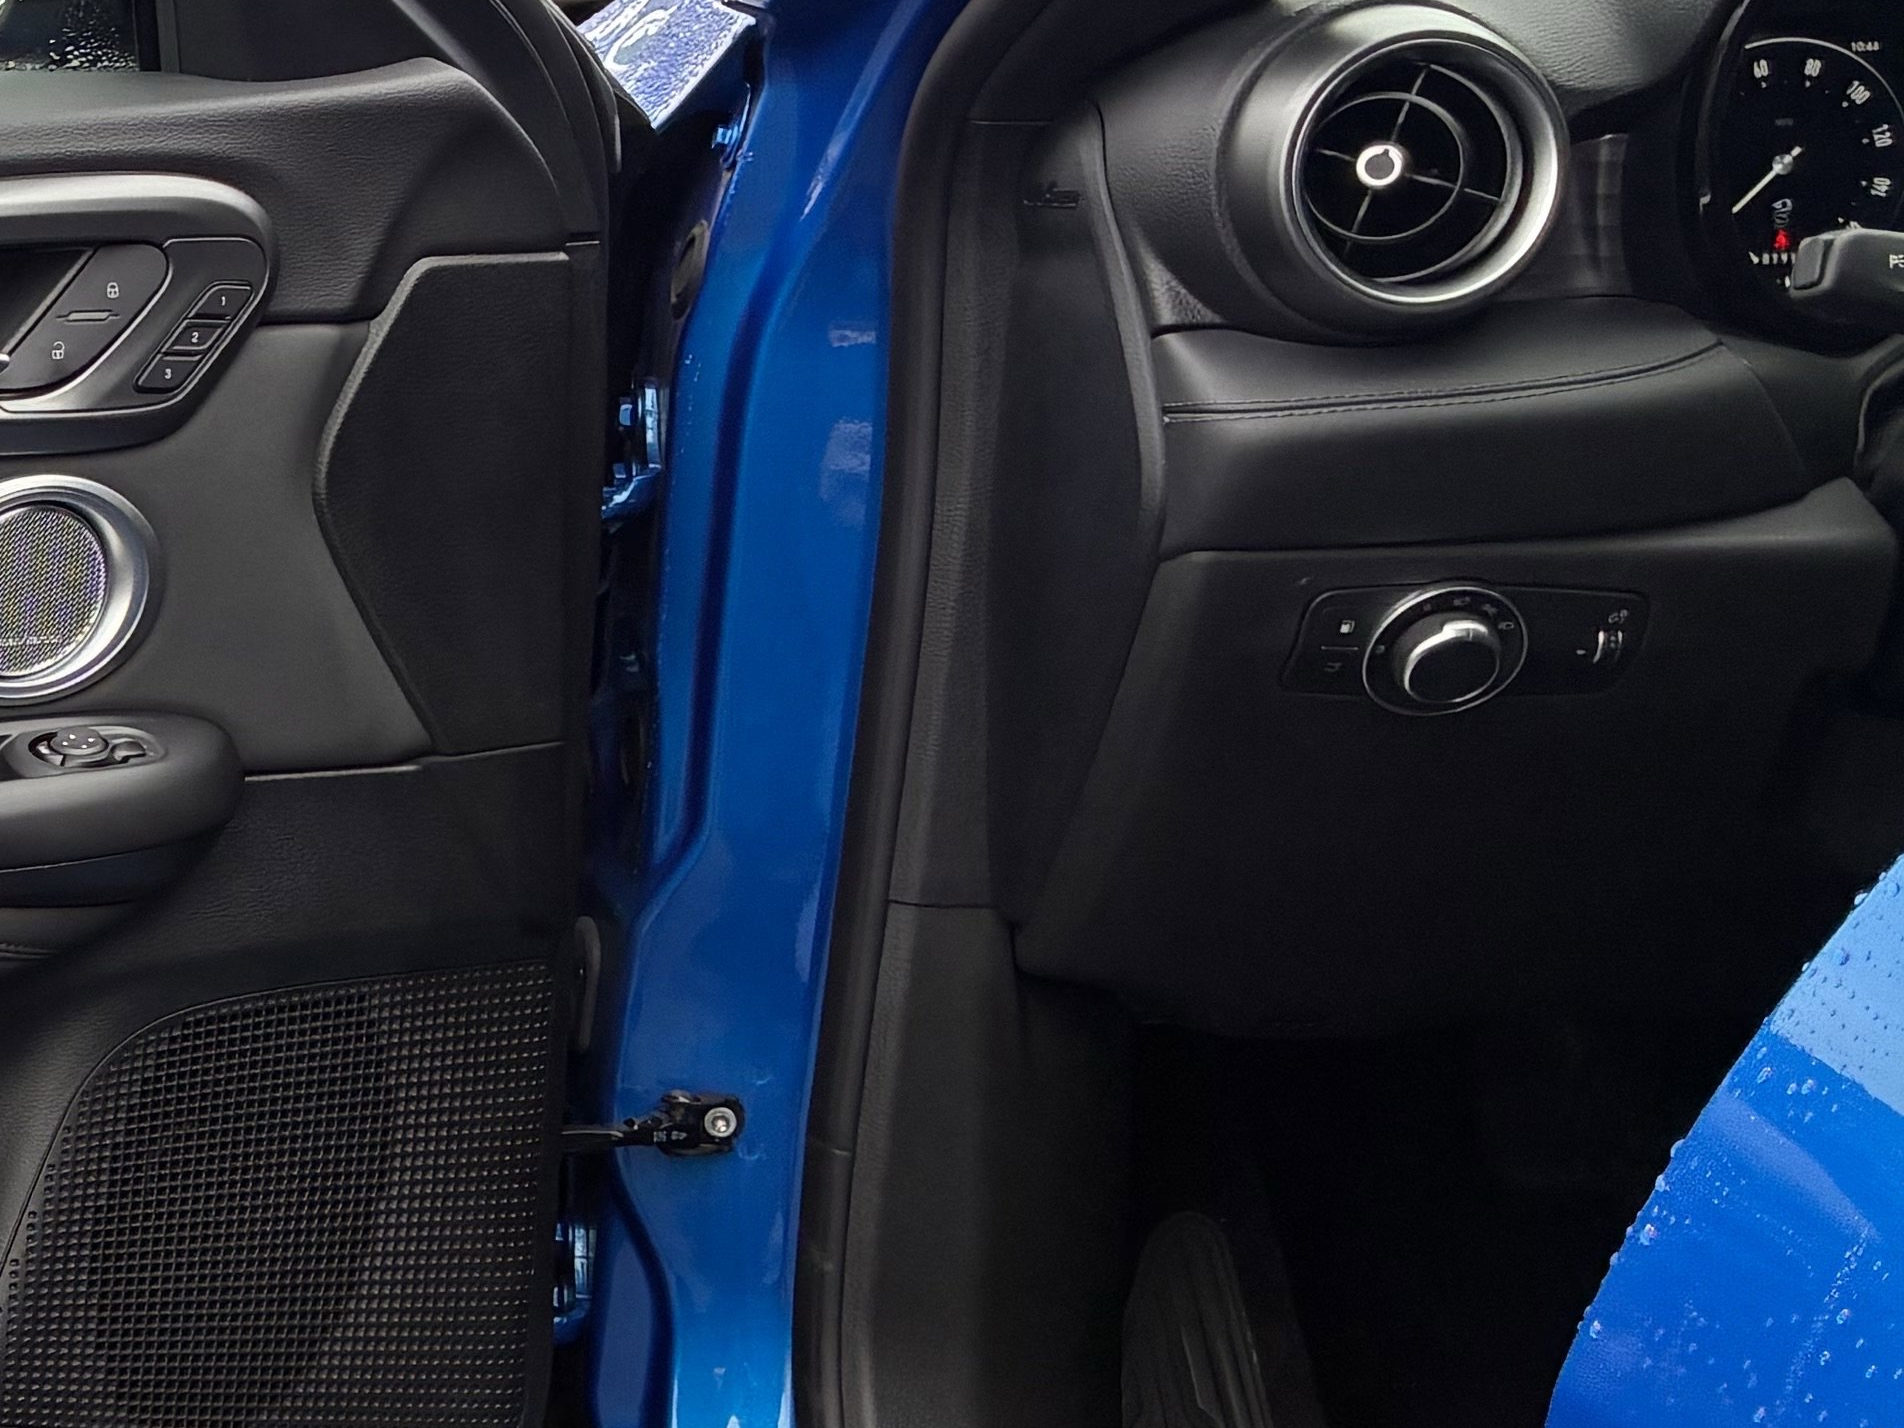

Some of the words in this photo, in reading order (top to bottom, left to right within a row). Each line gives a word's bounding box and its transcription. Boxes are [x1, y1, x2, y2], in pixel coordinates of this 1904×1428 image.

[1804, 58, 1822, 77] 80
[1846, 80, 1871, 105] 100
[1872, 124, 1893, 147] 120
[1870, 177, 1891, 197] 140
[221, 296, 226, 306] 1
[191, 332, 199, 343] 2
[164, 368, 172, 379] 3
